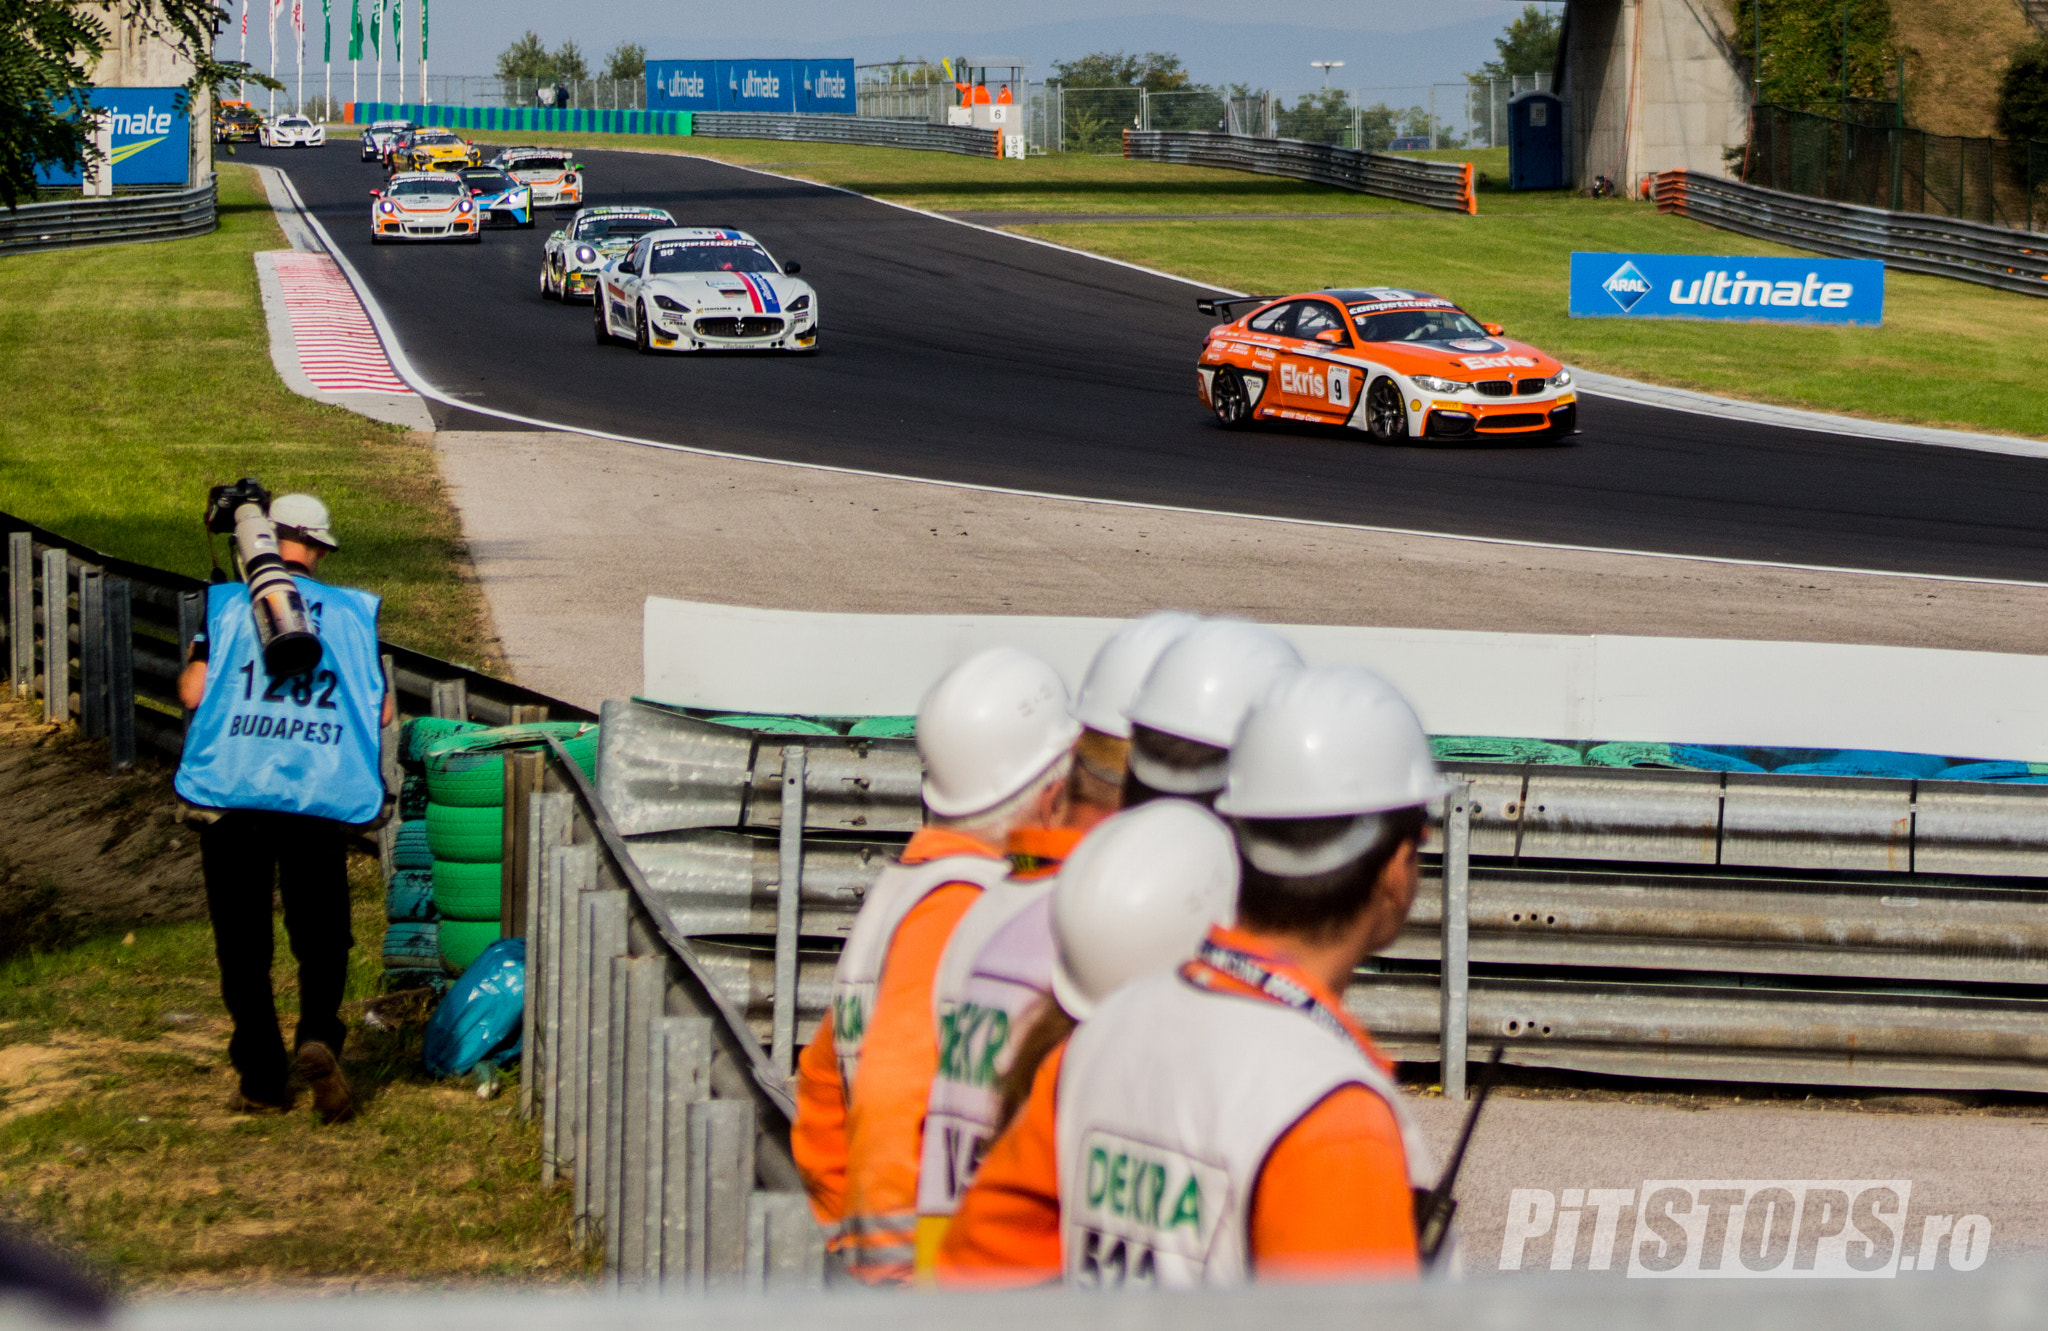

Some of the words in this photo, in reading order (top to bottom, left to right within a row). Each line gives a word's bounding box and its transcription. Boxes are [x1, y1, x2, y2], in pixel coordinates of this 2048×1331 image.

[669, 70, 704, 98] ultimate
[742, 70, 779, 98] ultimate
[815, 70, 845, 98] ultimate
[106, 106, 172, 134] imate
[994, 109, 1002, 120] 6
[1608, 279, 1646, 292] ARAL
[1669, 271, 1853, 308] ultimate
[1460, 355, 1535, 370] Ekris
[1280, 363, 1325, 398] Ekris
[1334, 379, 1342, 400] 9
[228, 715, 343, 746] BUDAPEST
[1087, 1148, 1200, 1230] DEKRA
